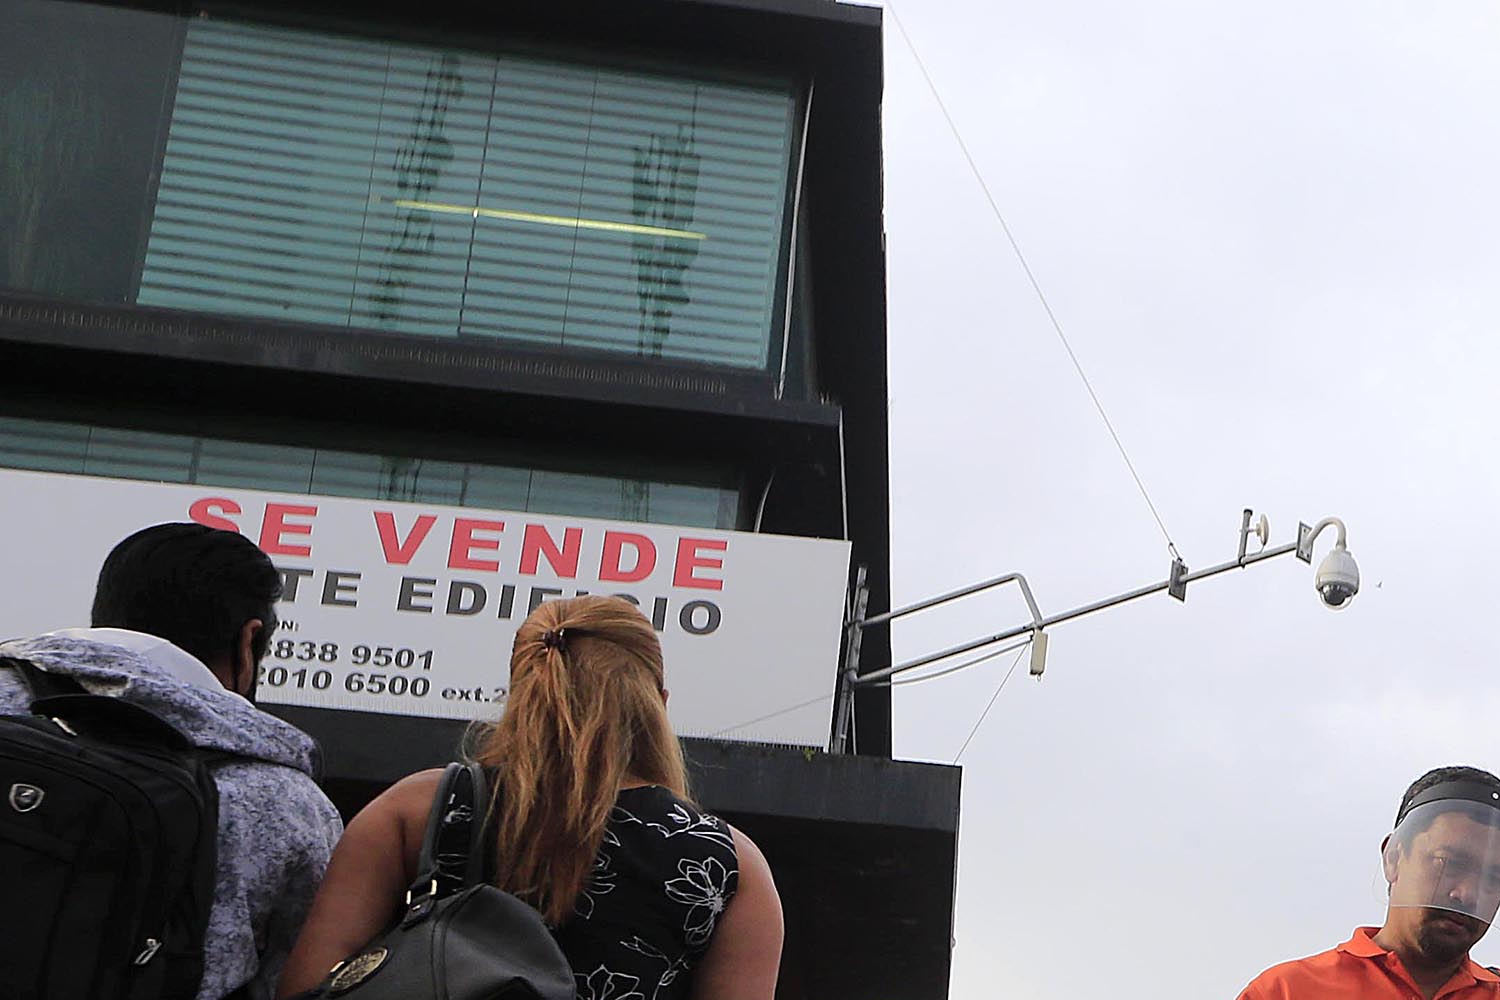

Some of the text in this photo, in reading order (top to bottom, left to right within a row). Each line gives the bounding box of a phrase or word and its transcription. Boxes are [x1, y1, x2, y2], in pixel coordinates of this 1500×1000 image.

[188, 497, 728, 591] SE VENDE
[396, 576, 723, 635] EDIFIO
[351, 645, 434, 670] 9501
[344, 673, 431, 697] 6500
